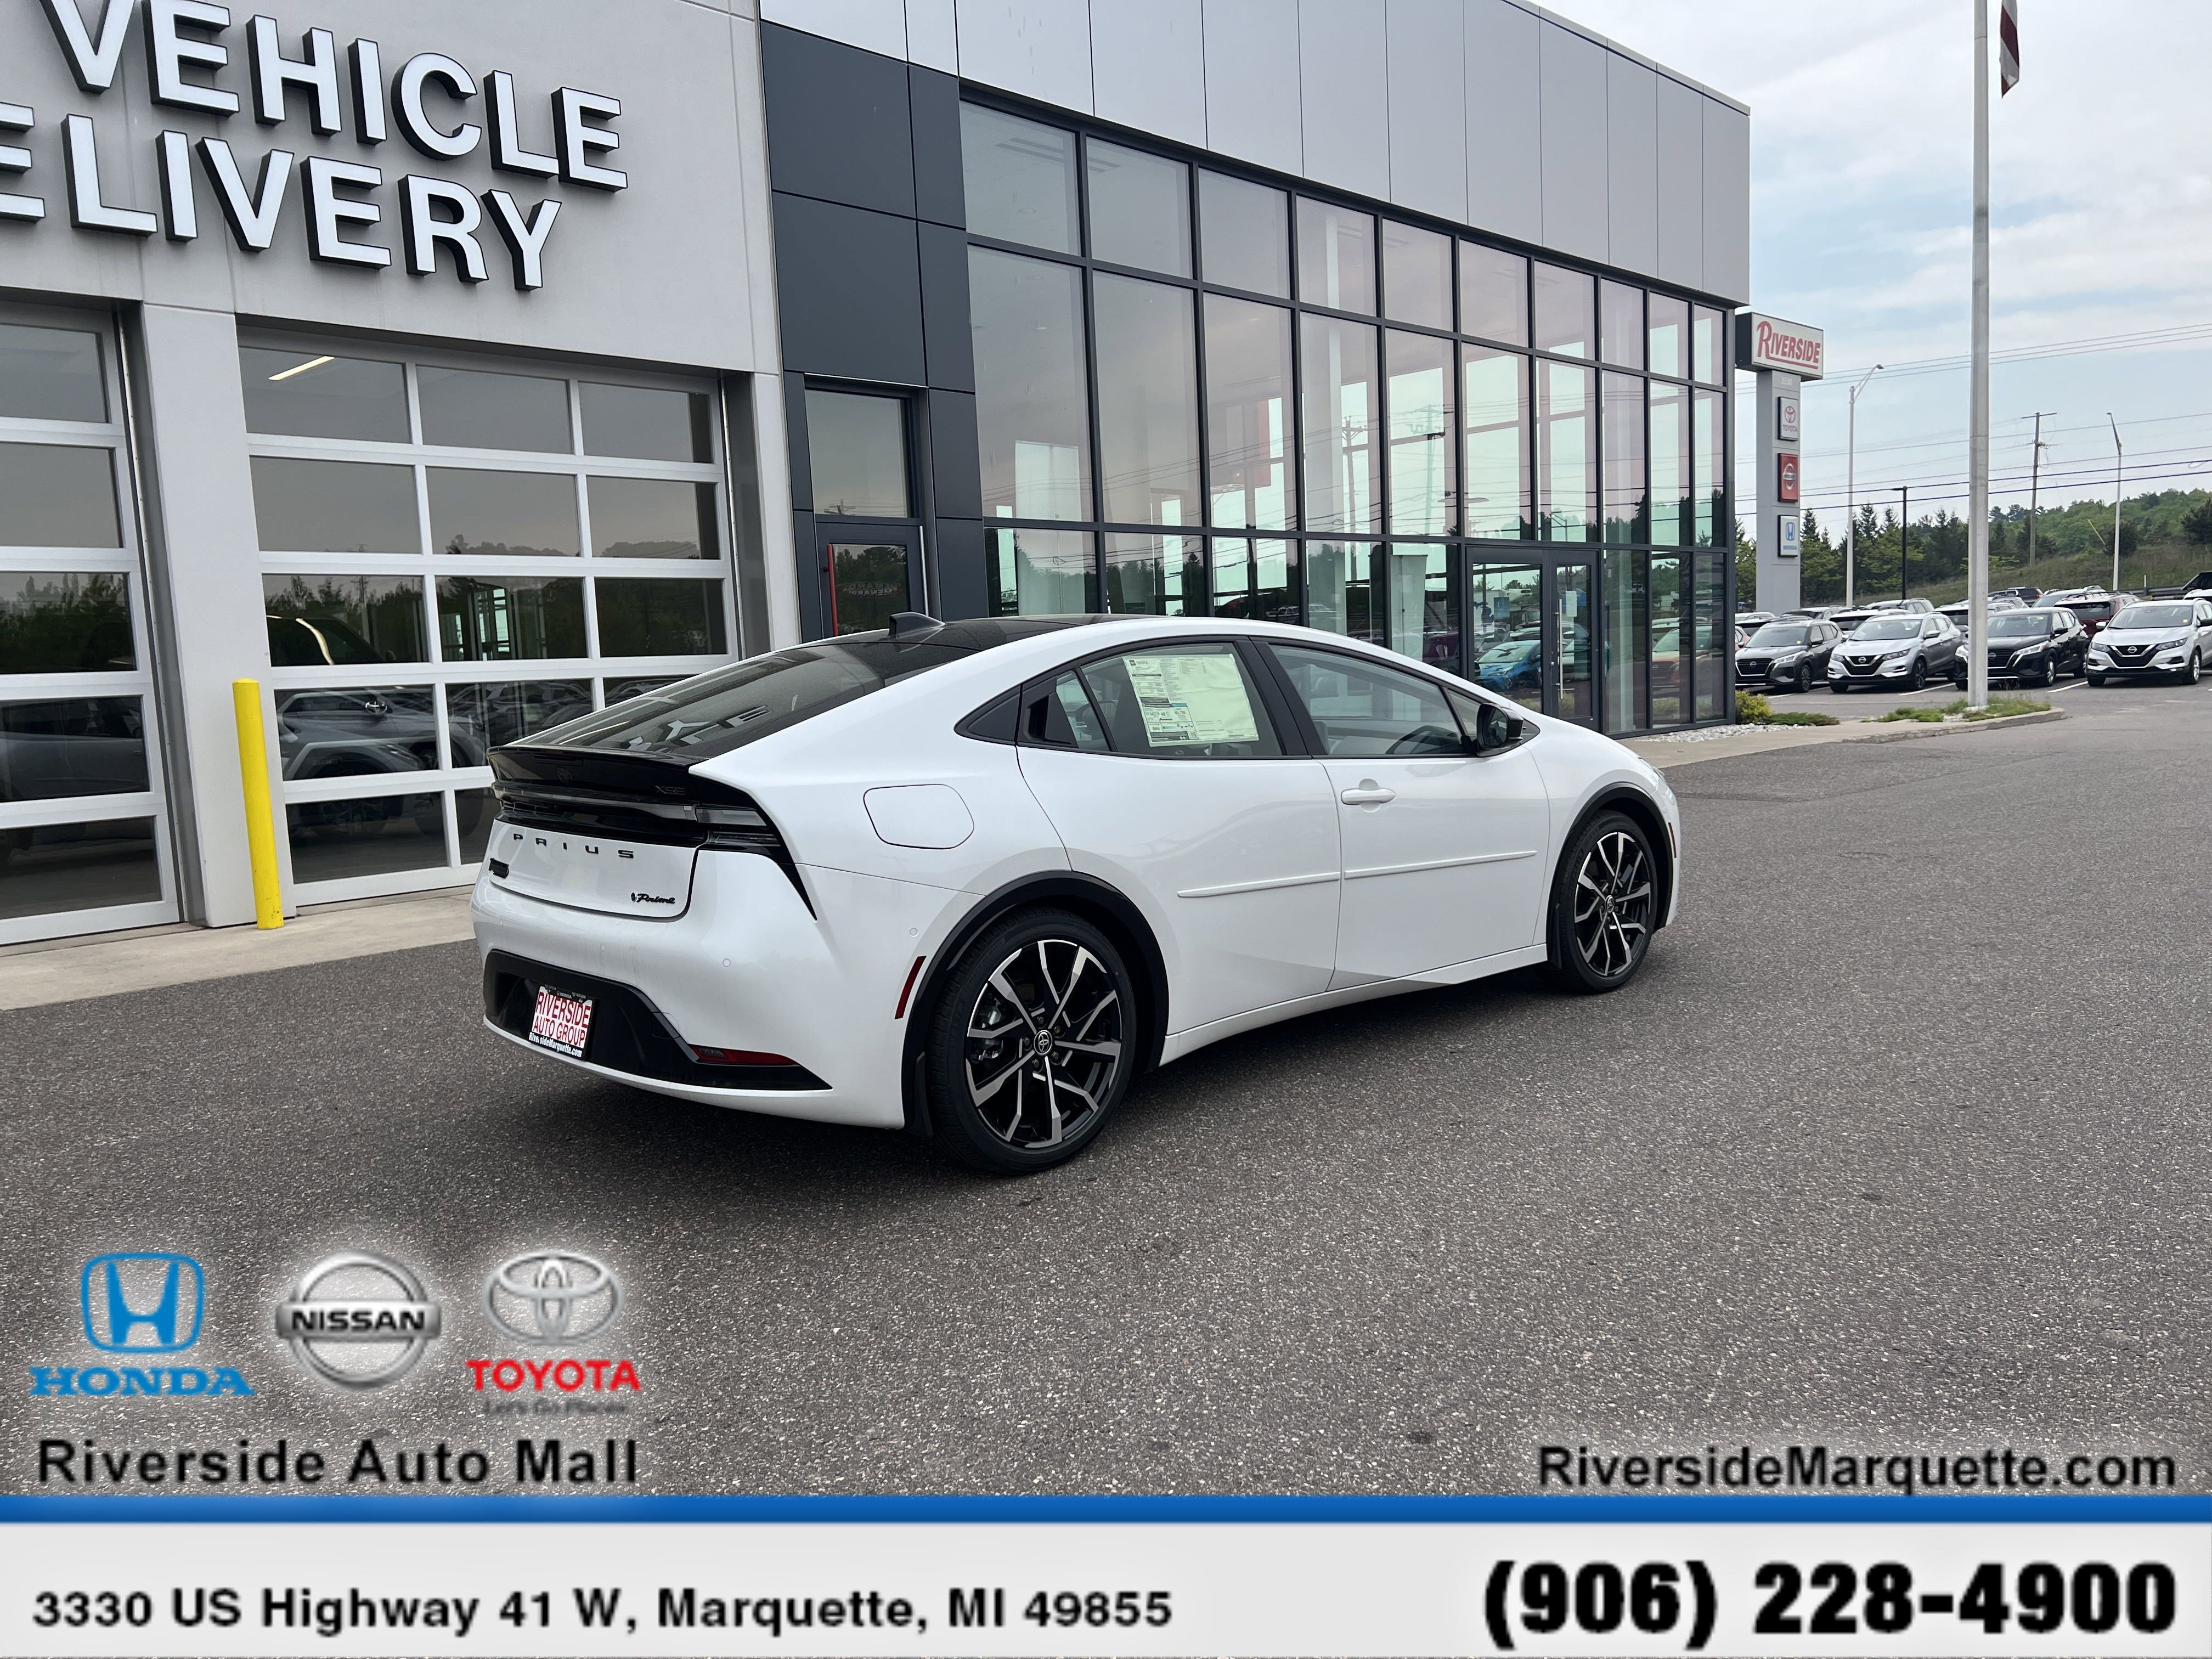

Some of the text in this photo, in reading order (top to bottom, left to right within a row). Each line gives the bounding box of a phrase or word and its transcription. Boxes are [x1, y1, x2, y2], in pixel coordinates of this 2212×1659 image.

[40, 0, 628, 193] VEHICLE
[1757, 321, 1821, 365] RIVERSIDE
[653, 786, 686, 796] XSE
[513, 833, 634, 859] PRIUS
[637, 893, 676, 904] Prime
[535, 991, 592, 1029] RIVERSIDE
[533, 1015, 586, 1047] AUTO GROUP
